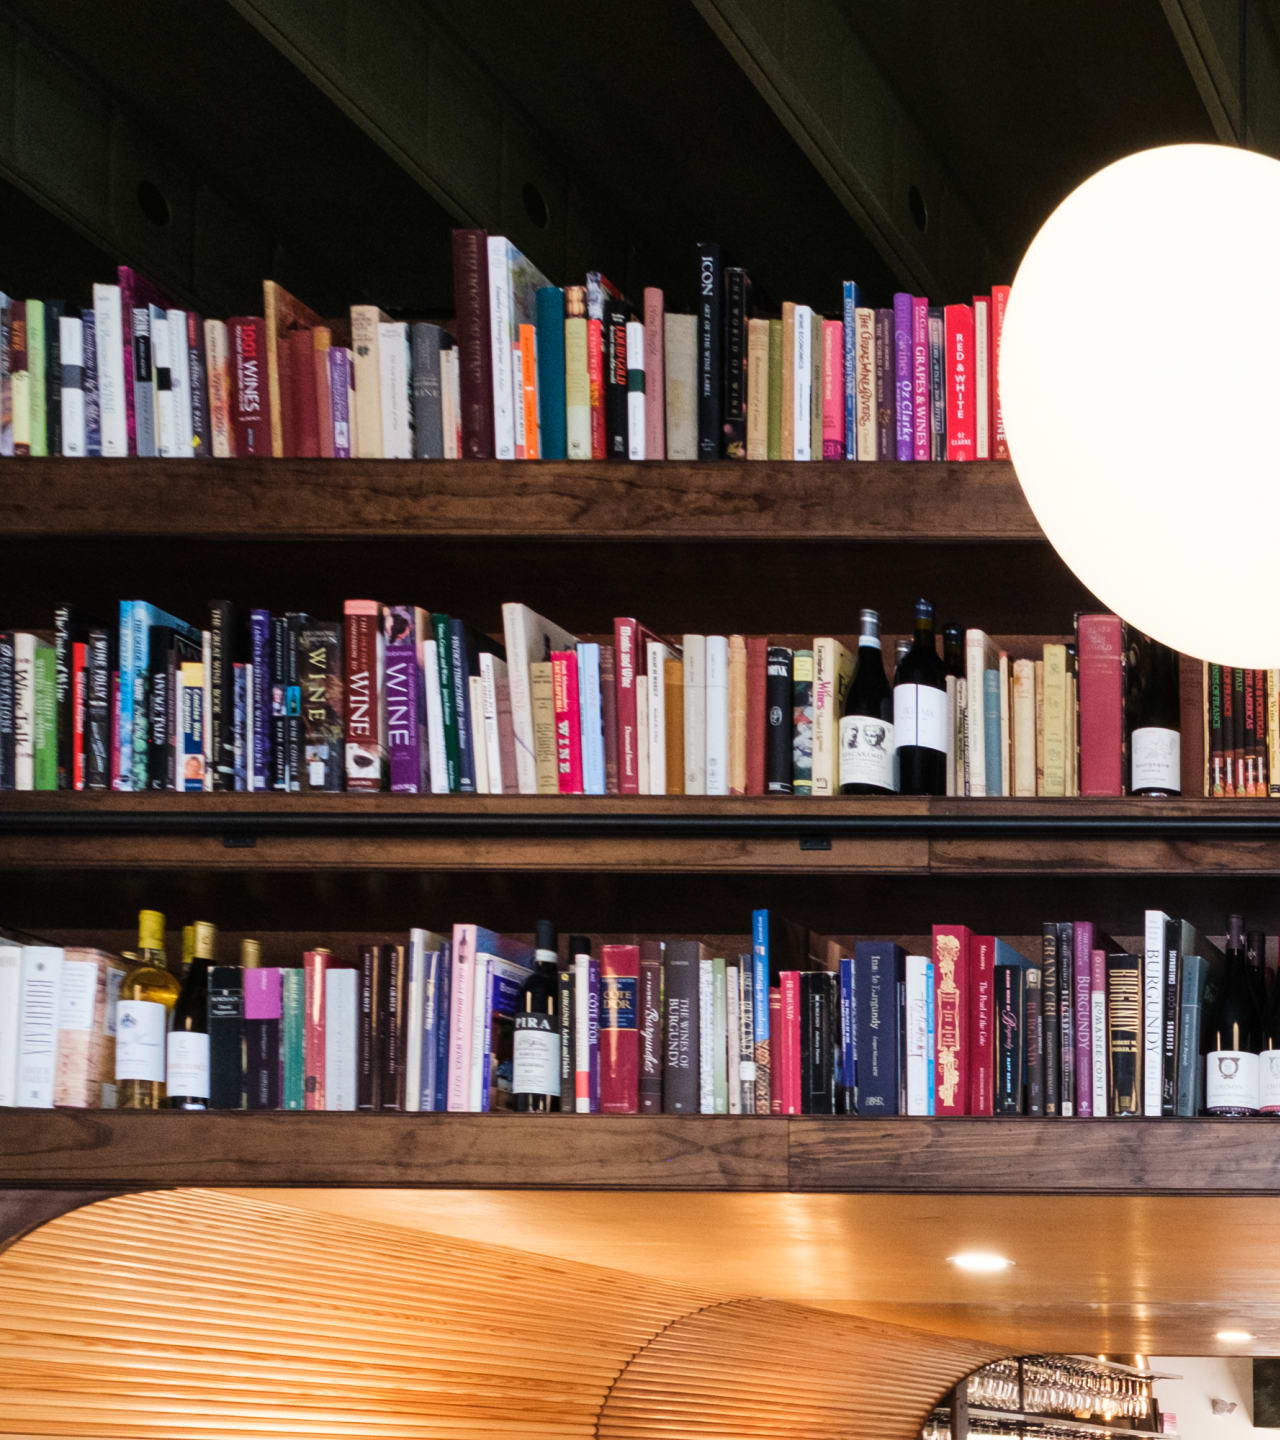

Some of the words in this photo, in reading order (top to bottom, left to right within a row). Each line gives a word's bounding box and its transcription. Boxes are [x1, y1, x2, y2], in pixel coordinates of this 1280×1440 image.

[701, 256, 713, 296] ICON
[704, 323, 711, 332] OF
[860, 313, 870, 328] THE
[243, 325, 256, 357] 1001
[615, 326, 625, 358] LIQUID
[860, 331, 873, 360] GREAT
[956, 333, 964, 360] RED
[617, 360, 626, 385] GOLD
[861, 362, 871, 388] WINE
[916, 346, 927, 385] GRAPES
[956, 364, 964, 372] &
[244, 360, 260, 411] WINES
[902, 381, 911, 398] Oz
[955, 375, 965, 418] WHITE
[902, 400, 911, 441] Clarke
[917, 407, 927, 445] WINES
[620, 627, 631, 651] Monks
[95, 641, 105, 667] WINE
[621, 653, 631, 667] and
[95, 670, 107, 698] FOLLY
[308, 648, 326, 721] WINE
[621, 668, 632, 688] Wine
[350, 672, 370, 736] WINE
[386, 663, 409, 747] WINE
[558, 720, 570, 773] WINE
[979, 981, 987, 993] The
[1109, 969, 1138, 1033] BURGUNDY
[679, 998, 689, 1018] THE
[979, 995, 987, 1010] Pearl
[1077, 976, 1090, 1050] BURGUNDY
[1146, 949, 1160, 1055] BURGUNDY
[668, 999, 679, 1068] BURGUNDY
[679, 1021, 689, 1051] WINES
[979, 1020, 987, 1030] the
[640, 1008, 657, 1073] Burgundies
[680, 1055, 689, 1068] OF
